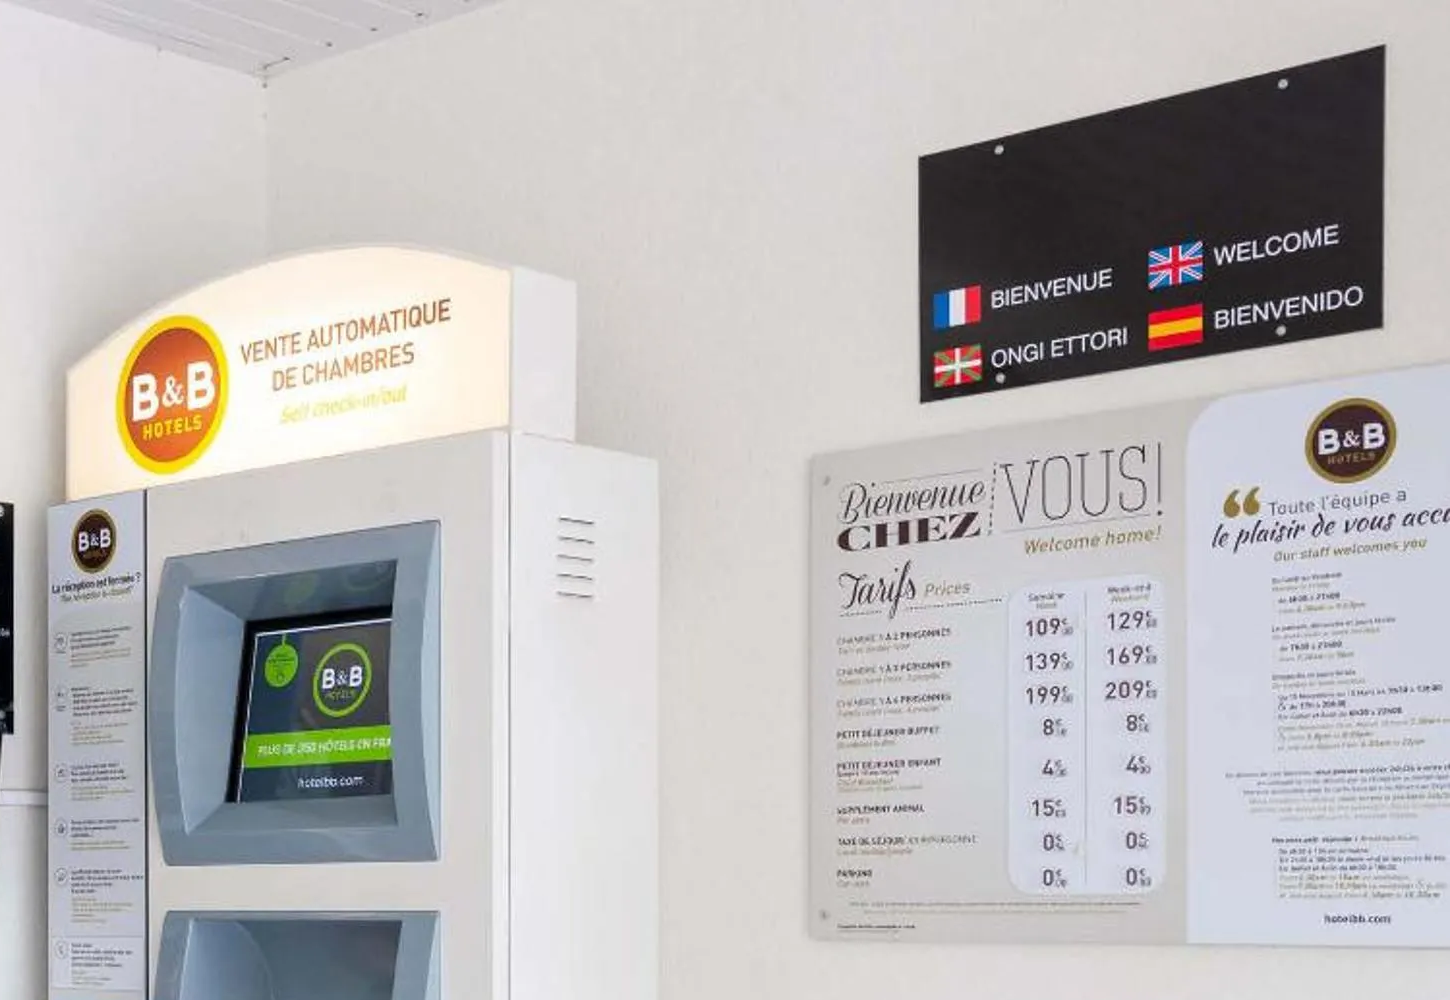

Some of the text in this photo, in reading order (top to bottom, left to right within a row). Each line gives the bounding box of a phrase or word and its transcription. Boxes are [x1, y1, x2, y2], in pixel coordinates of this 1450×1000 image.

[1213, 224, 1340, 267] WELCOME
[990, 267, 1113, 309] BIENVENUE
[1213, 285, 1364, 330] BIENVENIDO
[240, 298, 451, 366] VENTE AUTOMATIQUE
[990, 326, 1128, 368] ONGI ETTORI
[271, 341, 416, 392] DE CHAMBRES
[131, 360, 216, 423] B&B
[141, 414, 203, 441] HOTELS
[1317, 421, 1386, 455] B&B
[837, 480, 987, 525] Bienvenue
[1267, 500, 1316, 517] Toute
[1395, 489, 1407, 502] a
[78, 527, 111, 552] B&B
[836, 511, 983, 552] CHEZ
[1023, 525, 1164, 556] Welcome home!
[1210, 522, 1230, 549] le
[1232, 519, 1307, 554] plaisir
[1311, 513, 1337, 538] de
[1343, 512, 1396, 534] vous
[1272, 538, 1428, 563] Our staff welcomes you
[837, 559, 972, 619] Tarifs Prices
[321, 664, 364, 690] B&B
